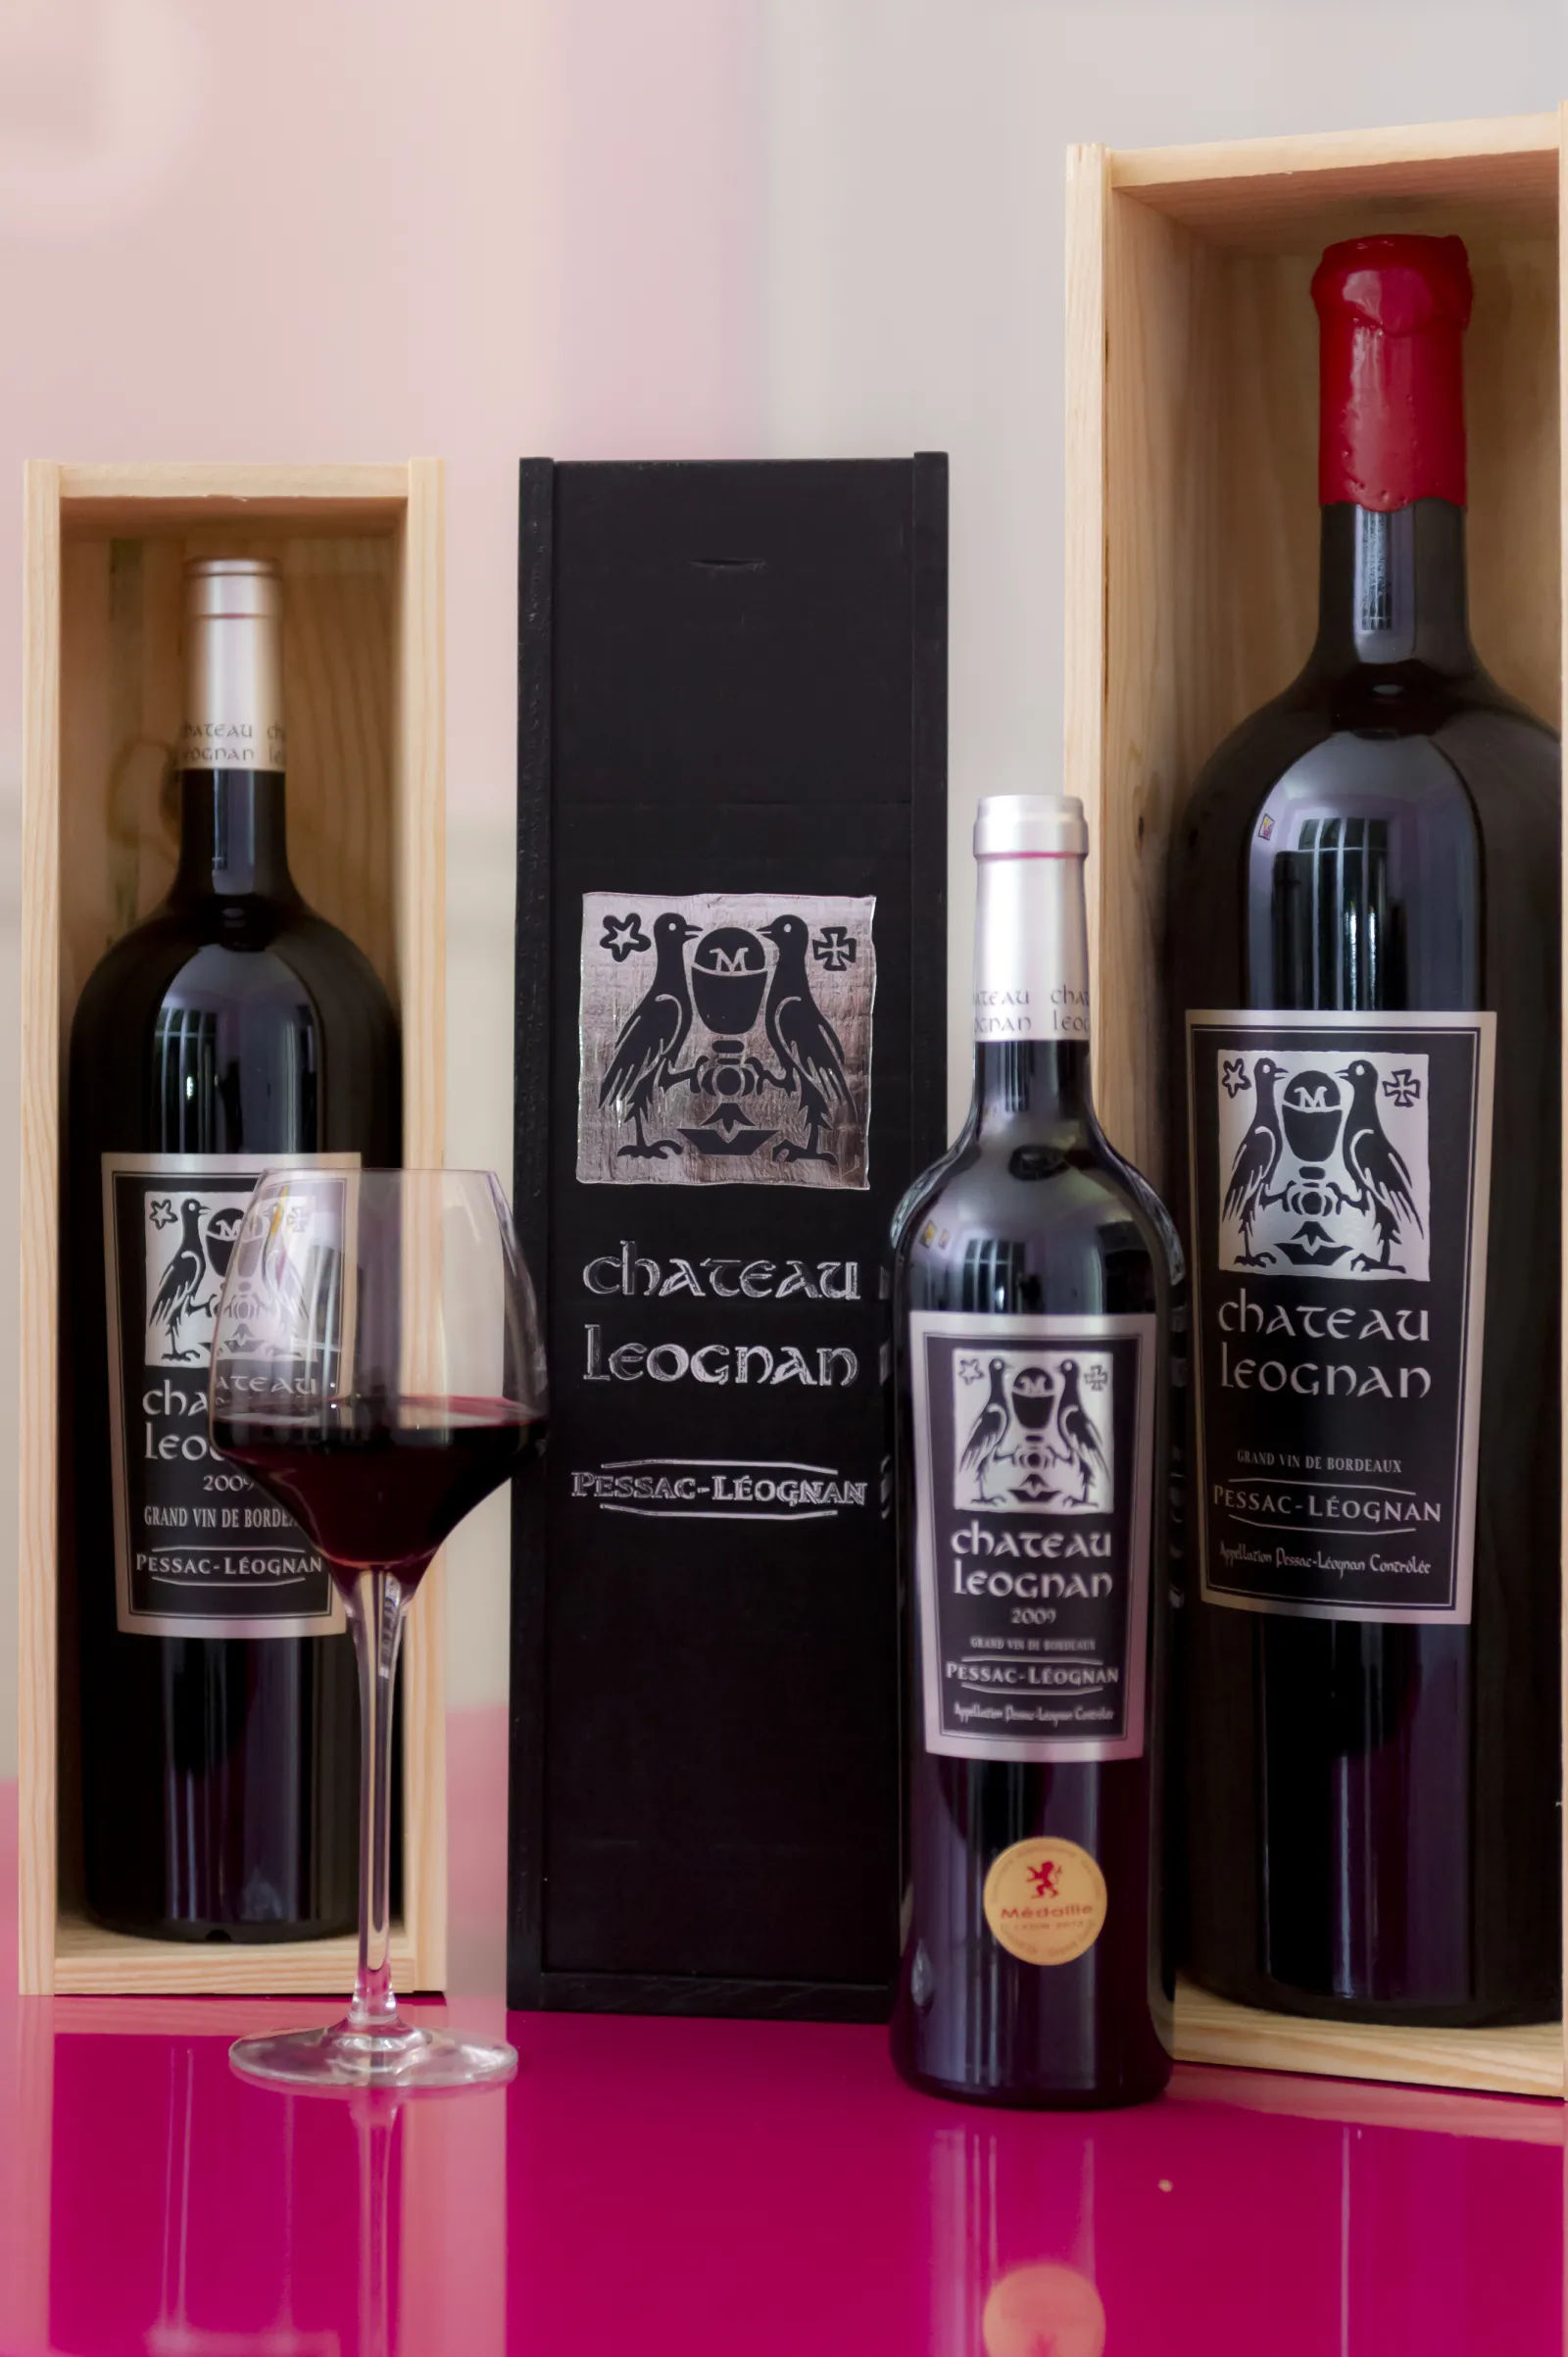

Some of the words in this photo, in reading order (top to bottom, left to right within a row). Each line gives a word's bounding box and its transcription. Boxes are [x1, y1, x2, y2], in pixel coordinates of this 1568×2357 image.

[709, 947, 750, 974] M
[1294, 1086, 1328, 1108] M
[1237, 1449, 1275, 1466] GRAND
[1279, 1452, 1300, 1469] VIN
[1305, 1455, 1322, 1470] DE
[1327, 1456, 1402, 1474] BORDEAUX
[570, 1471, 868, 1506] PESSAC-LÉOGNAN
[1213, 1484, 1442, 1523] PESSAC-LÉOGNAN
[144, 1505, 188, 1528] GRAND
[193, 1507, 217, 1528] VIN
[221, 1507, 240, 1528] DE
[135, 1553, 322, 1577] PESSAC-LÉOGNAN
[1009, 1606, 1057, 1626] 2009
[970, 1636, 1004, 1650] GRAND
[1006, 1638, 1025, 1651] VIN
[1028, 1638, 1041, 1651] DE
[1043, 1638, 1097, 1652] BORDEAUX
[945, 1661, 1120, 1686] PESSAC-LÉOGNAN
